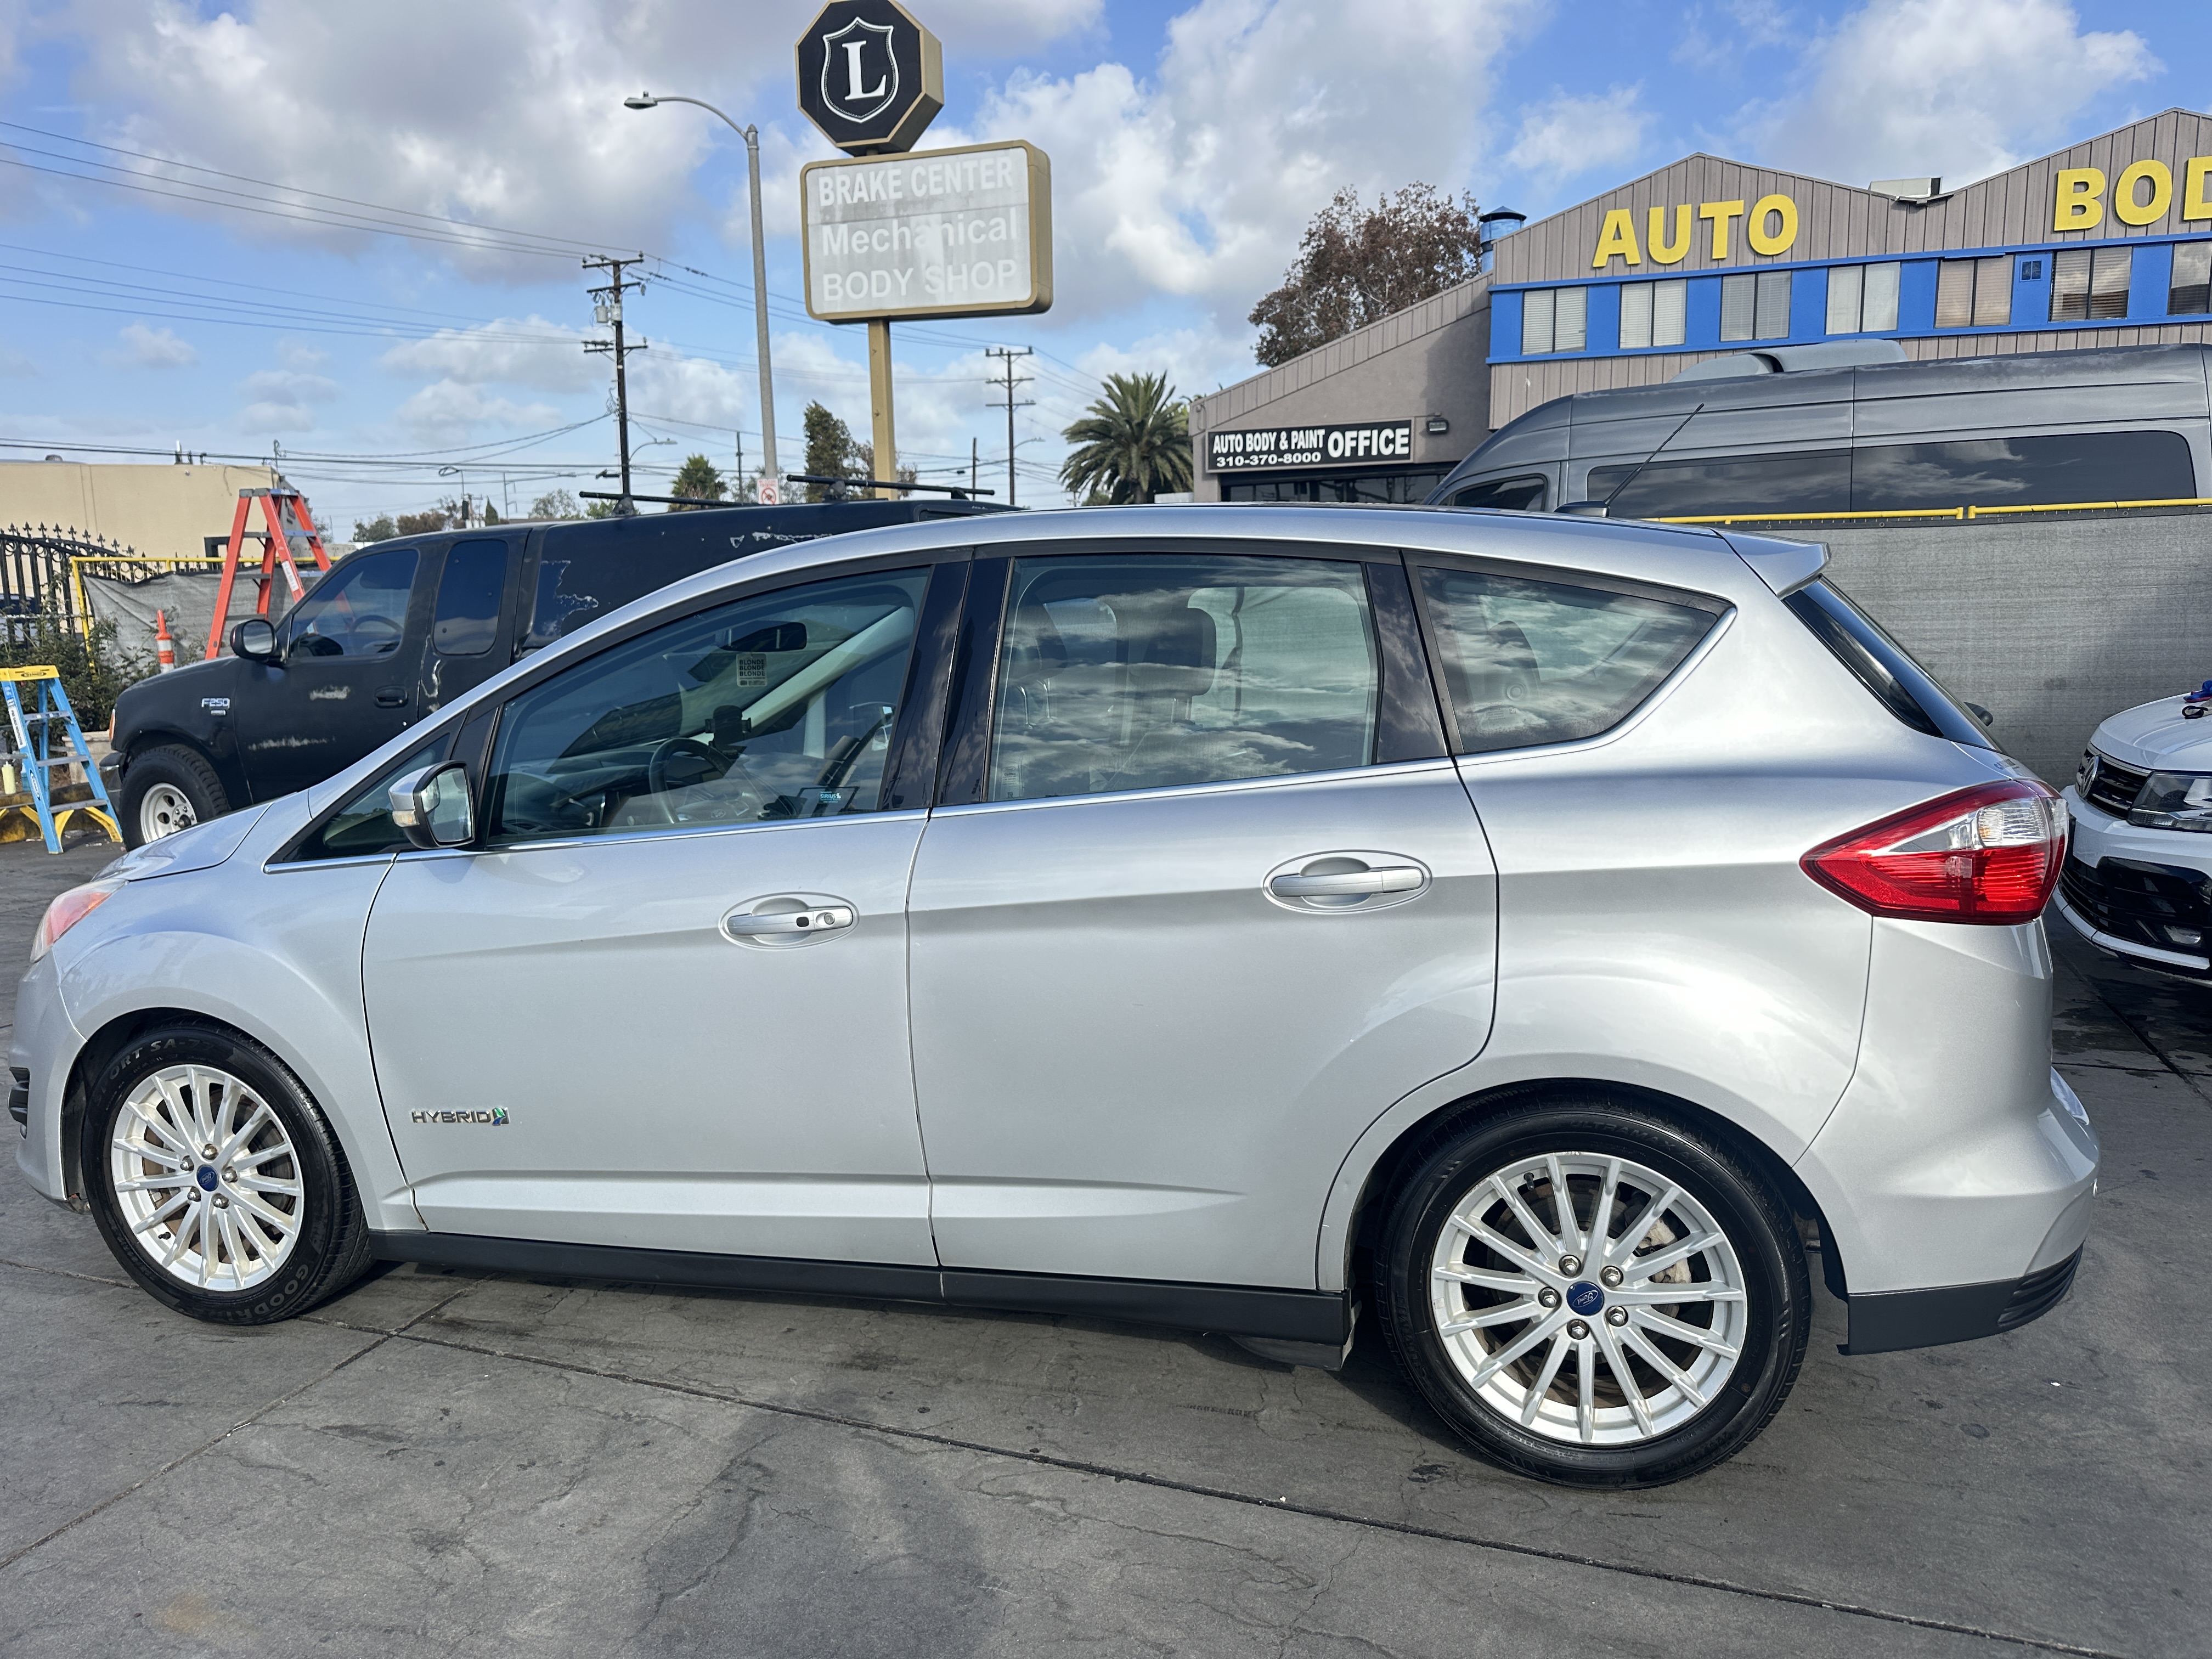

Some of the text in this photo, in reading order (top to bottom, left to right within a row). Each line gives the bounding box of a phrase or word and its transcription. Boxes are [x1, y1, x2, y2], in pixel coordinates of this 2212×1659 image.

[842, 40, 887, 101] L
[819, 156, 1012, 207] BRAKE CENTER
[822, 208, 1018, 256] Mechanical
[1593, 194, 1798, 268] AUTO
[823, 259, 1018, 301] BODY SHOP
[1212, 427, 1410, 458] AUTO BODY & PAINT OFFICE
[1216, 452, 1322, 467] 310-370-8000
[411, 1110, 492, 1123] HYBRID
[208, 1264, 309, 1322] GOODRI
